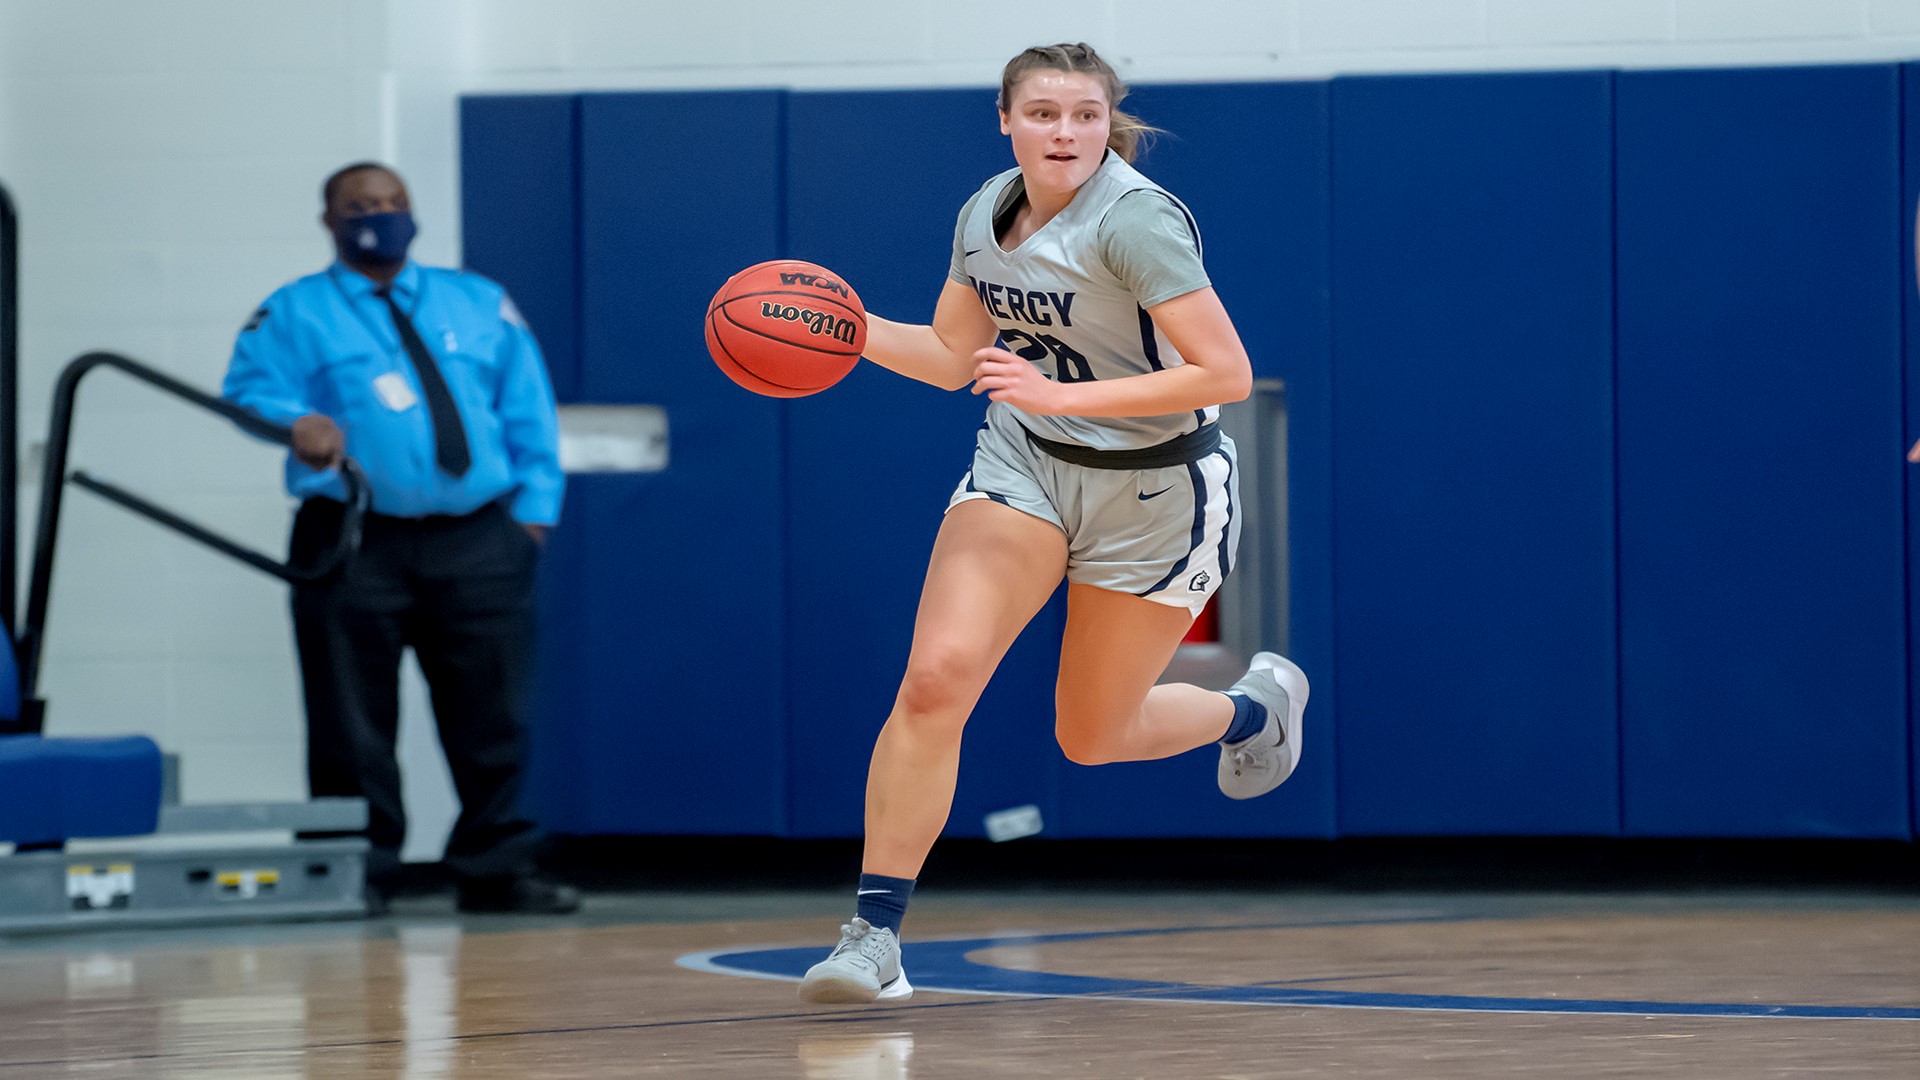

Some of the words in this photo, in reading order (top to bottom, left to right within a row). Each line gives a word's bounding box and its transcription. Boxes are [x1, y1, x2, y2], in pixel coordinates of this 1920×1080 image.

[780, 272, 848, 299] NCAA
[968, 275, 1076, 327] MERCY
[761, 301, 857, 346] Wilson
